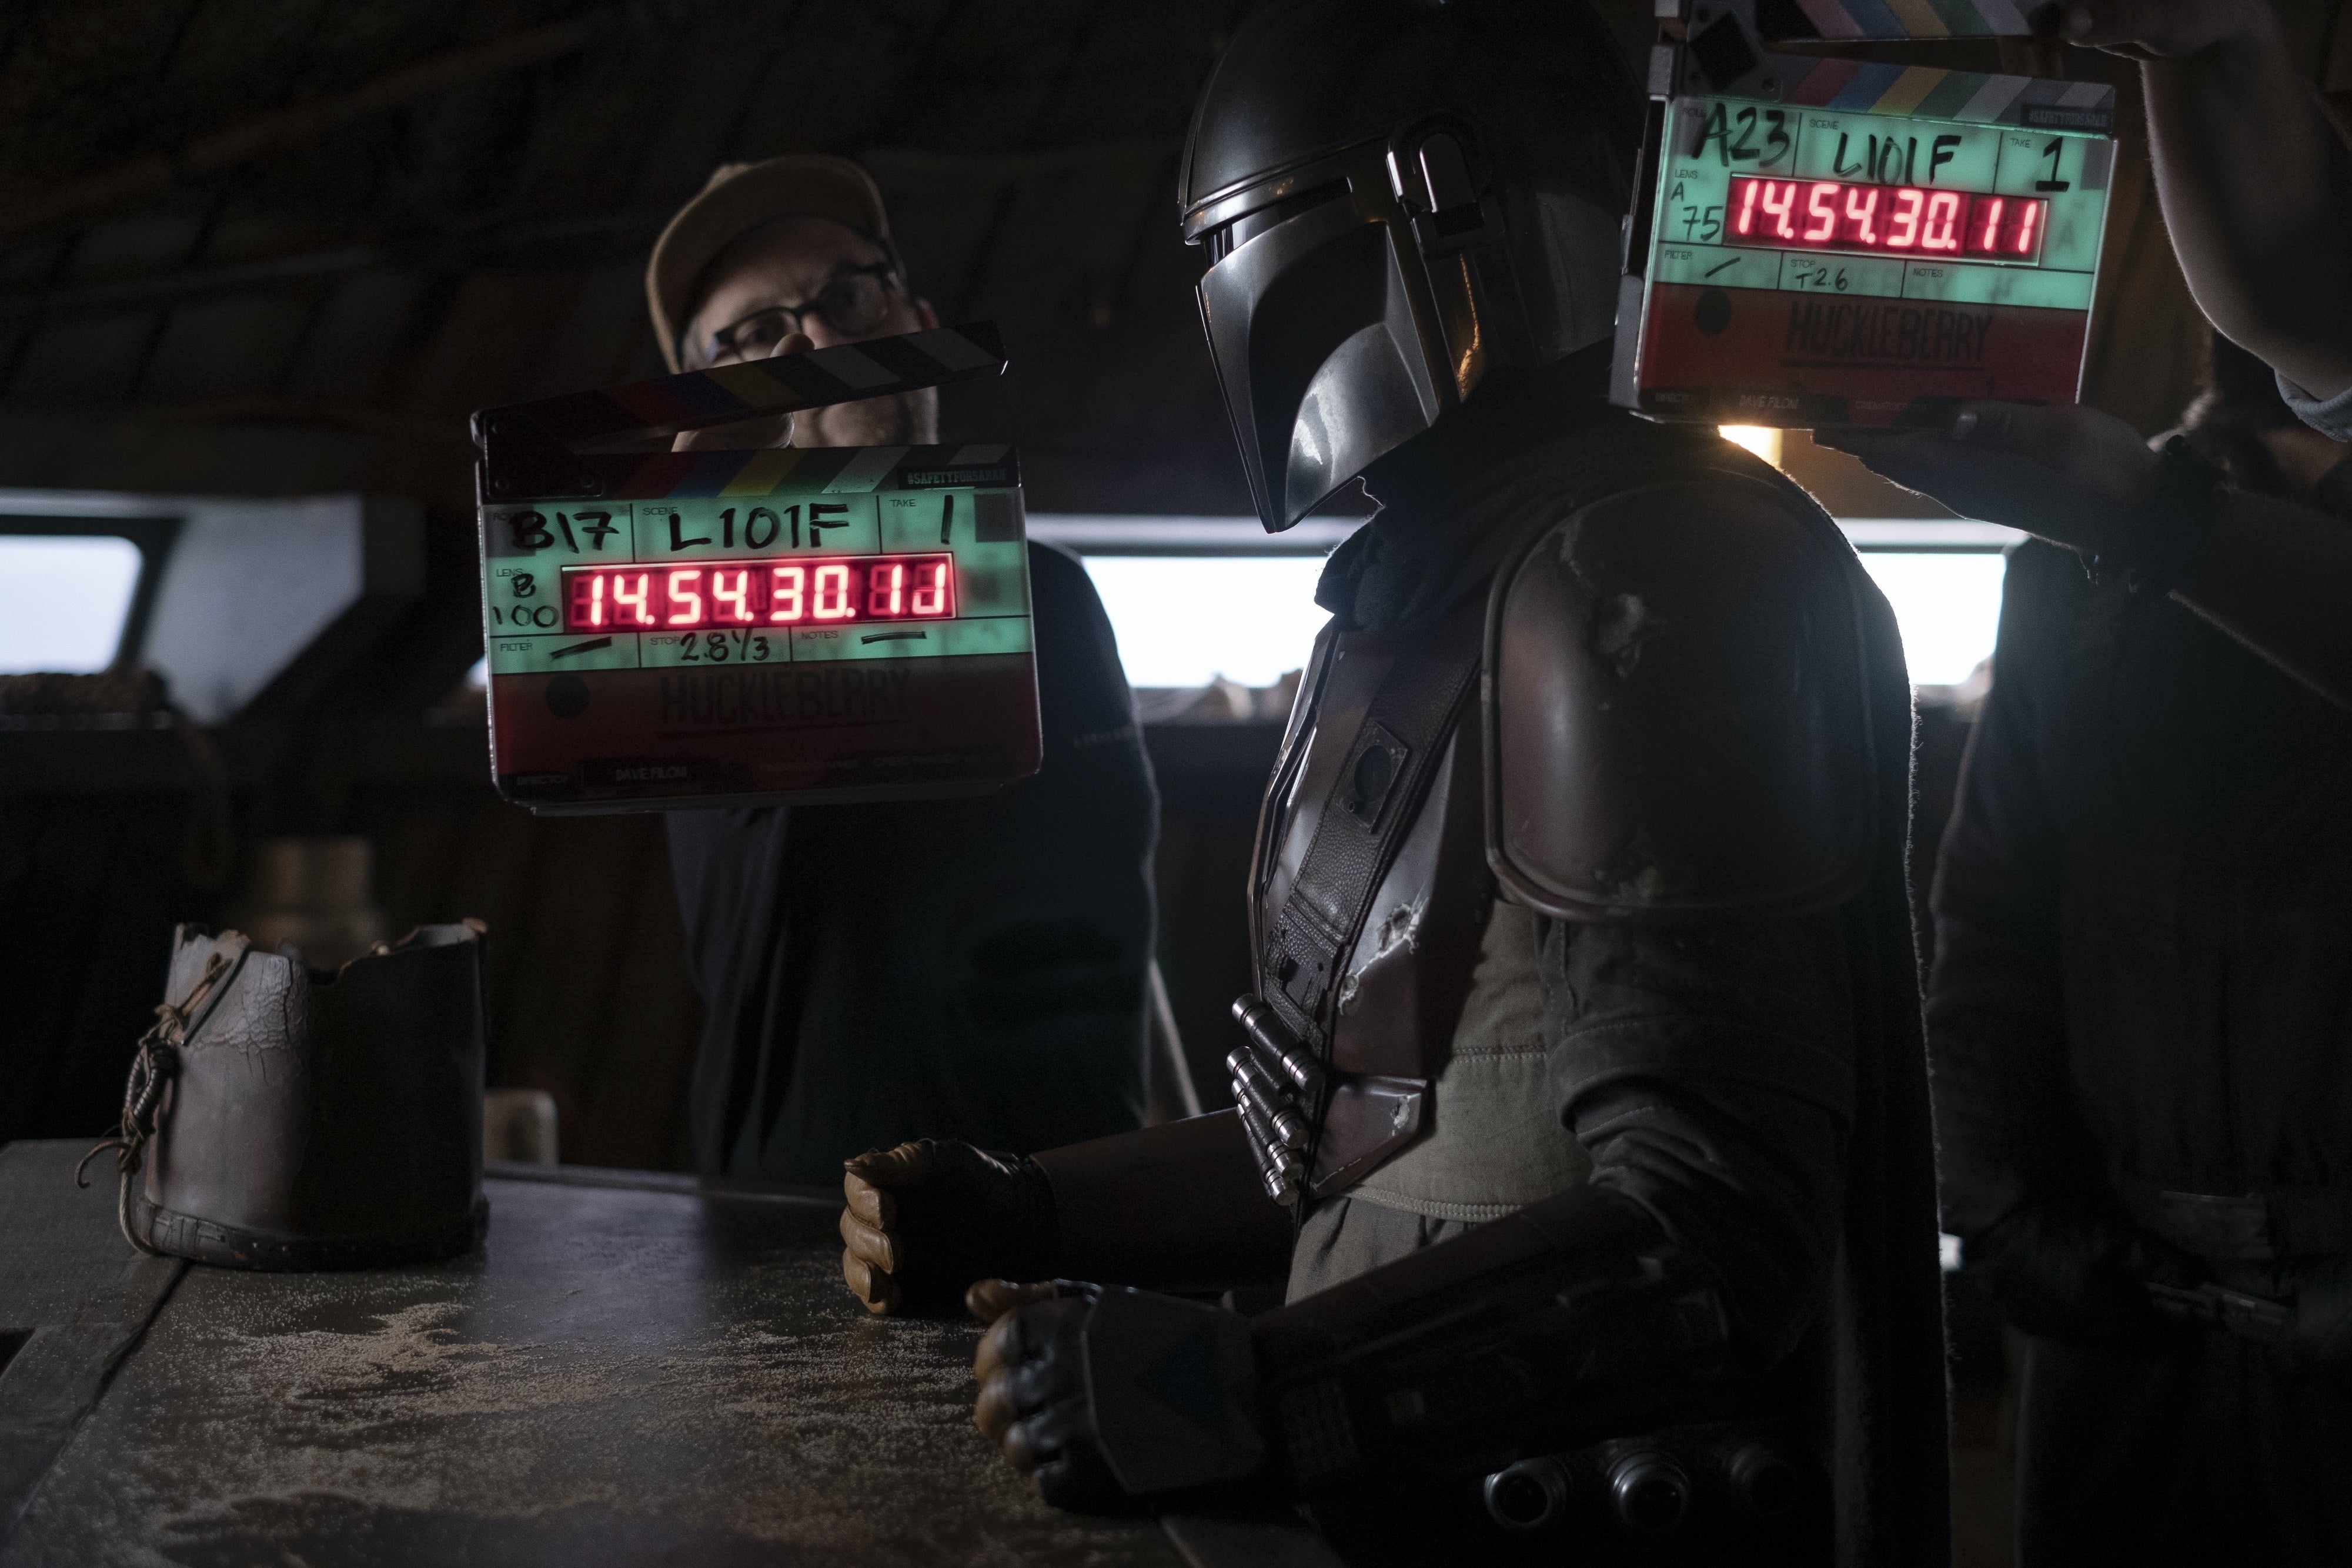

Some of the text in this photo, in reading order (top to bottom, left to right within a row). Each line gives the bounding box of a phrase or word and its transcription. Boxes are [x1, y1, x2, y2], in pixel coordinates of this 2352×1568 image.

[1809, 119, 1839, 130] SCENE
[1692, 102, 1790, 168] A23
[2010, 138, 2031, 148] TAKE
[2034, 136, 2070, 192] 1
[1675, 169, 1698, 179] LENS
[1669, 181, 1684, 202] A
[1682, 206, 1723, 242] 75
[1664, 249, 1693, 260] FILTER
[1790, 259, 1816, 268] STOP
[1913, 268, 1943, 278] NOTES
[1786, 300, 1994, 362] HUCKLEBERRY
[890, 499, 916, 507] TAKE
[642, 506, 678, 516] SCENE
[509, 510, 619, 554] B17
[496, 567, 523, 577] LENS
[492, 604, 559, 628] 100
[801, 630, 838, 640] NOTES
[500, 642, 532, 651] FILTER
[650, 637, 680, 646] STOP
[660, 667, 911, 724] HUCKLEBERRY
